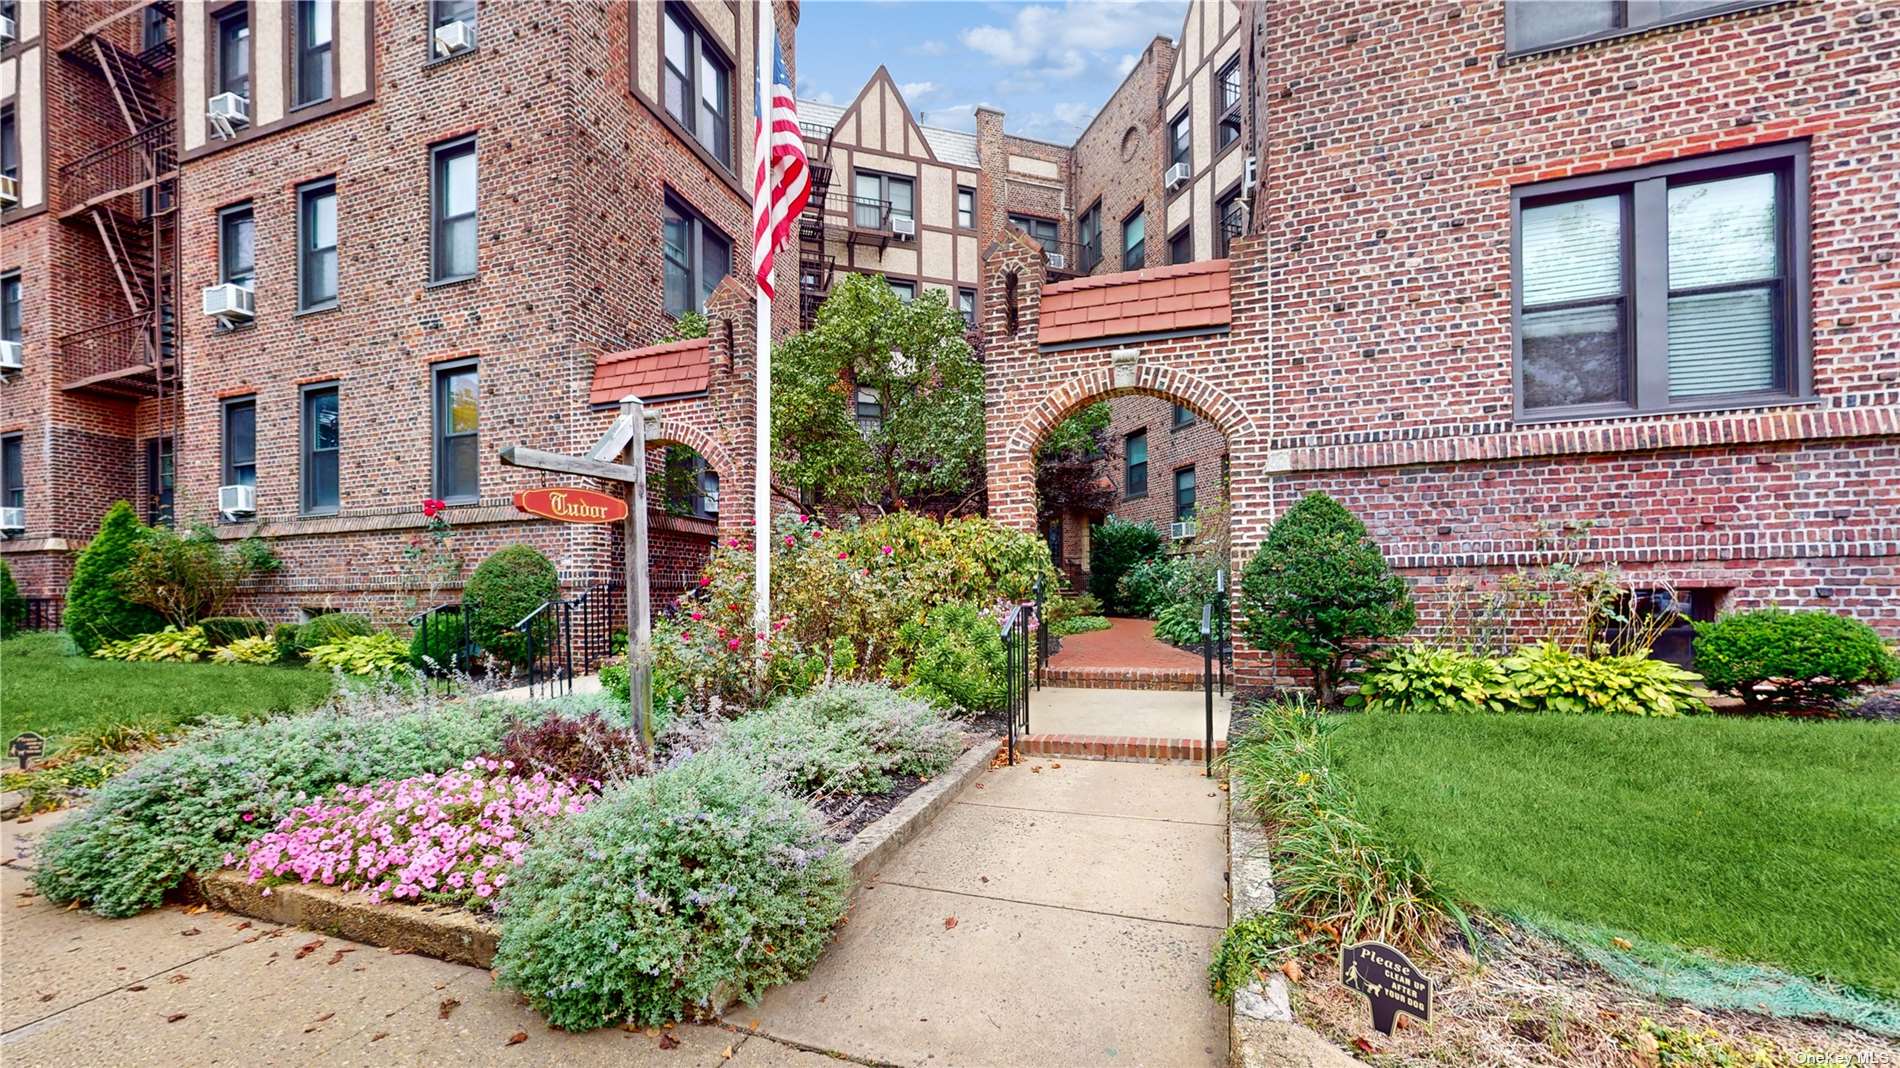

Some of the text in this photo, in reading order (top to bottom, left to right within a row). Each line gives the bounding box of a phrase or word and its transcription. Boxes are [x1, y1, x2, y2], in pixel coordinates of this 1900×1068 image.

[549, 491, 608, 518] Tudor
[1360, 948, 1411, 976] Please
[1384, 969, 1426, 991] CLEAN UP
[1391, 982, 1418, 998] AFTER
[1384, 987, 1425, 1011] YOUR DOG
